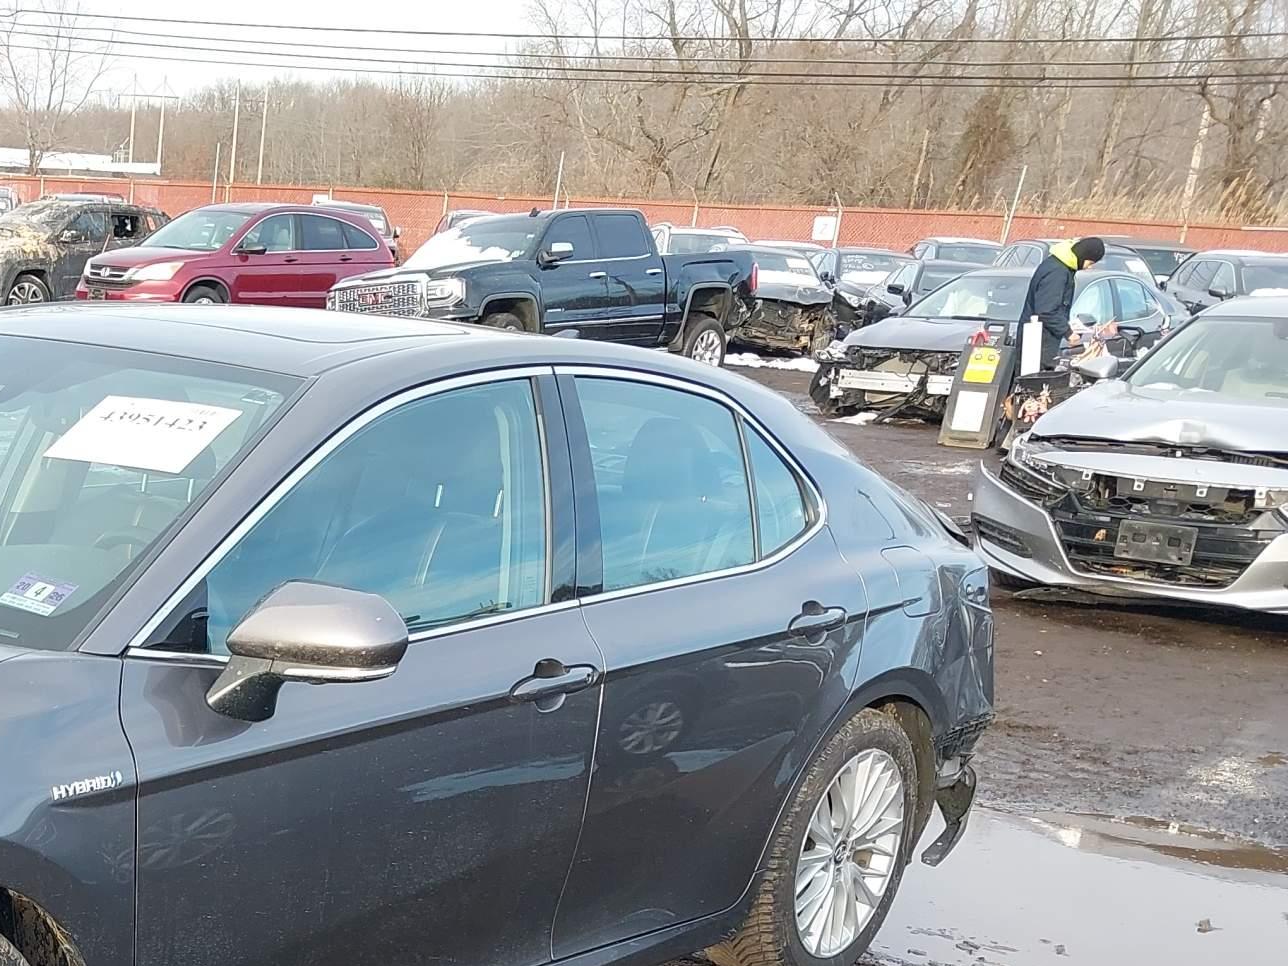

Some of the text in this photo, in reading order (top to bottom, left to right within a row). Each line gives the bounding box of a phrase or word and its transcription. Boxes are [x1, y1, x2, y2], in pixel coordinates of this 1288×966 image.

[359, 292, 392, 305] GMC
[34, 586, 47, 597] 4
[52, 775, 113, 800] HYBRID
